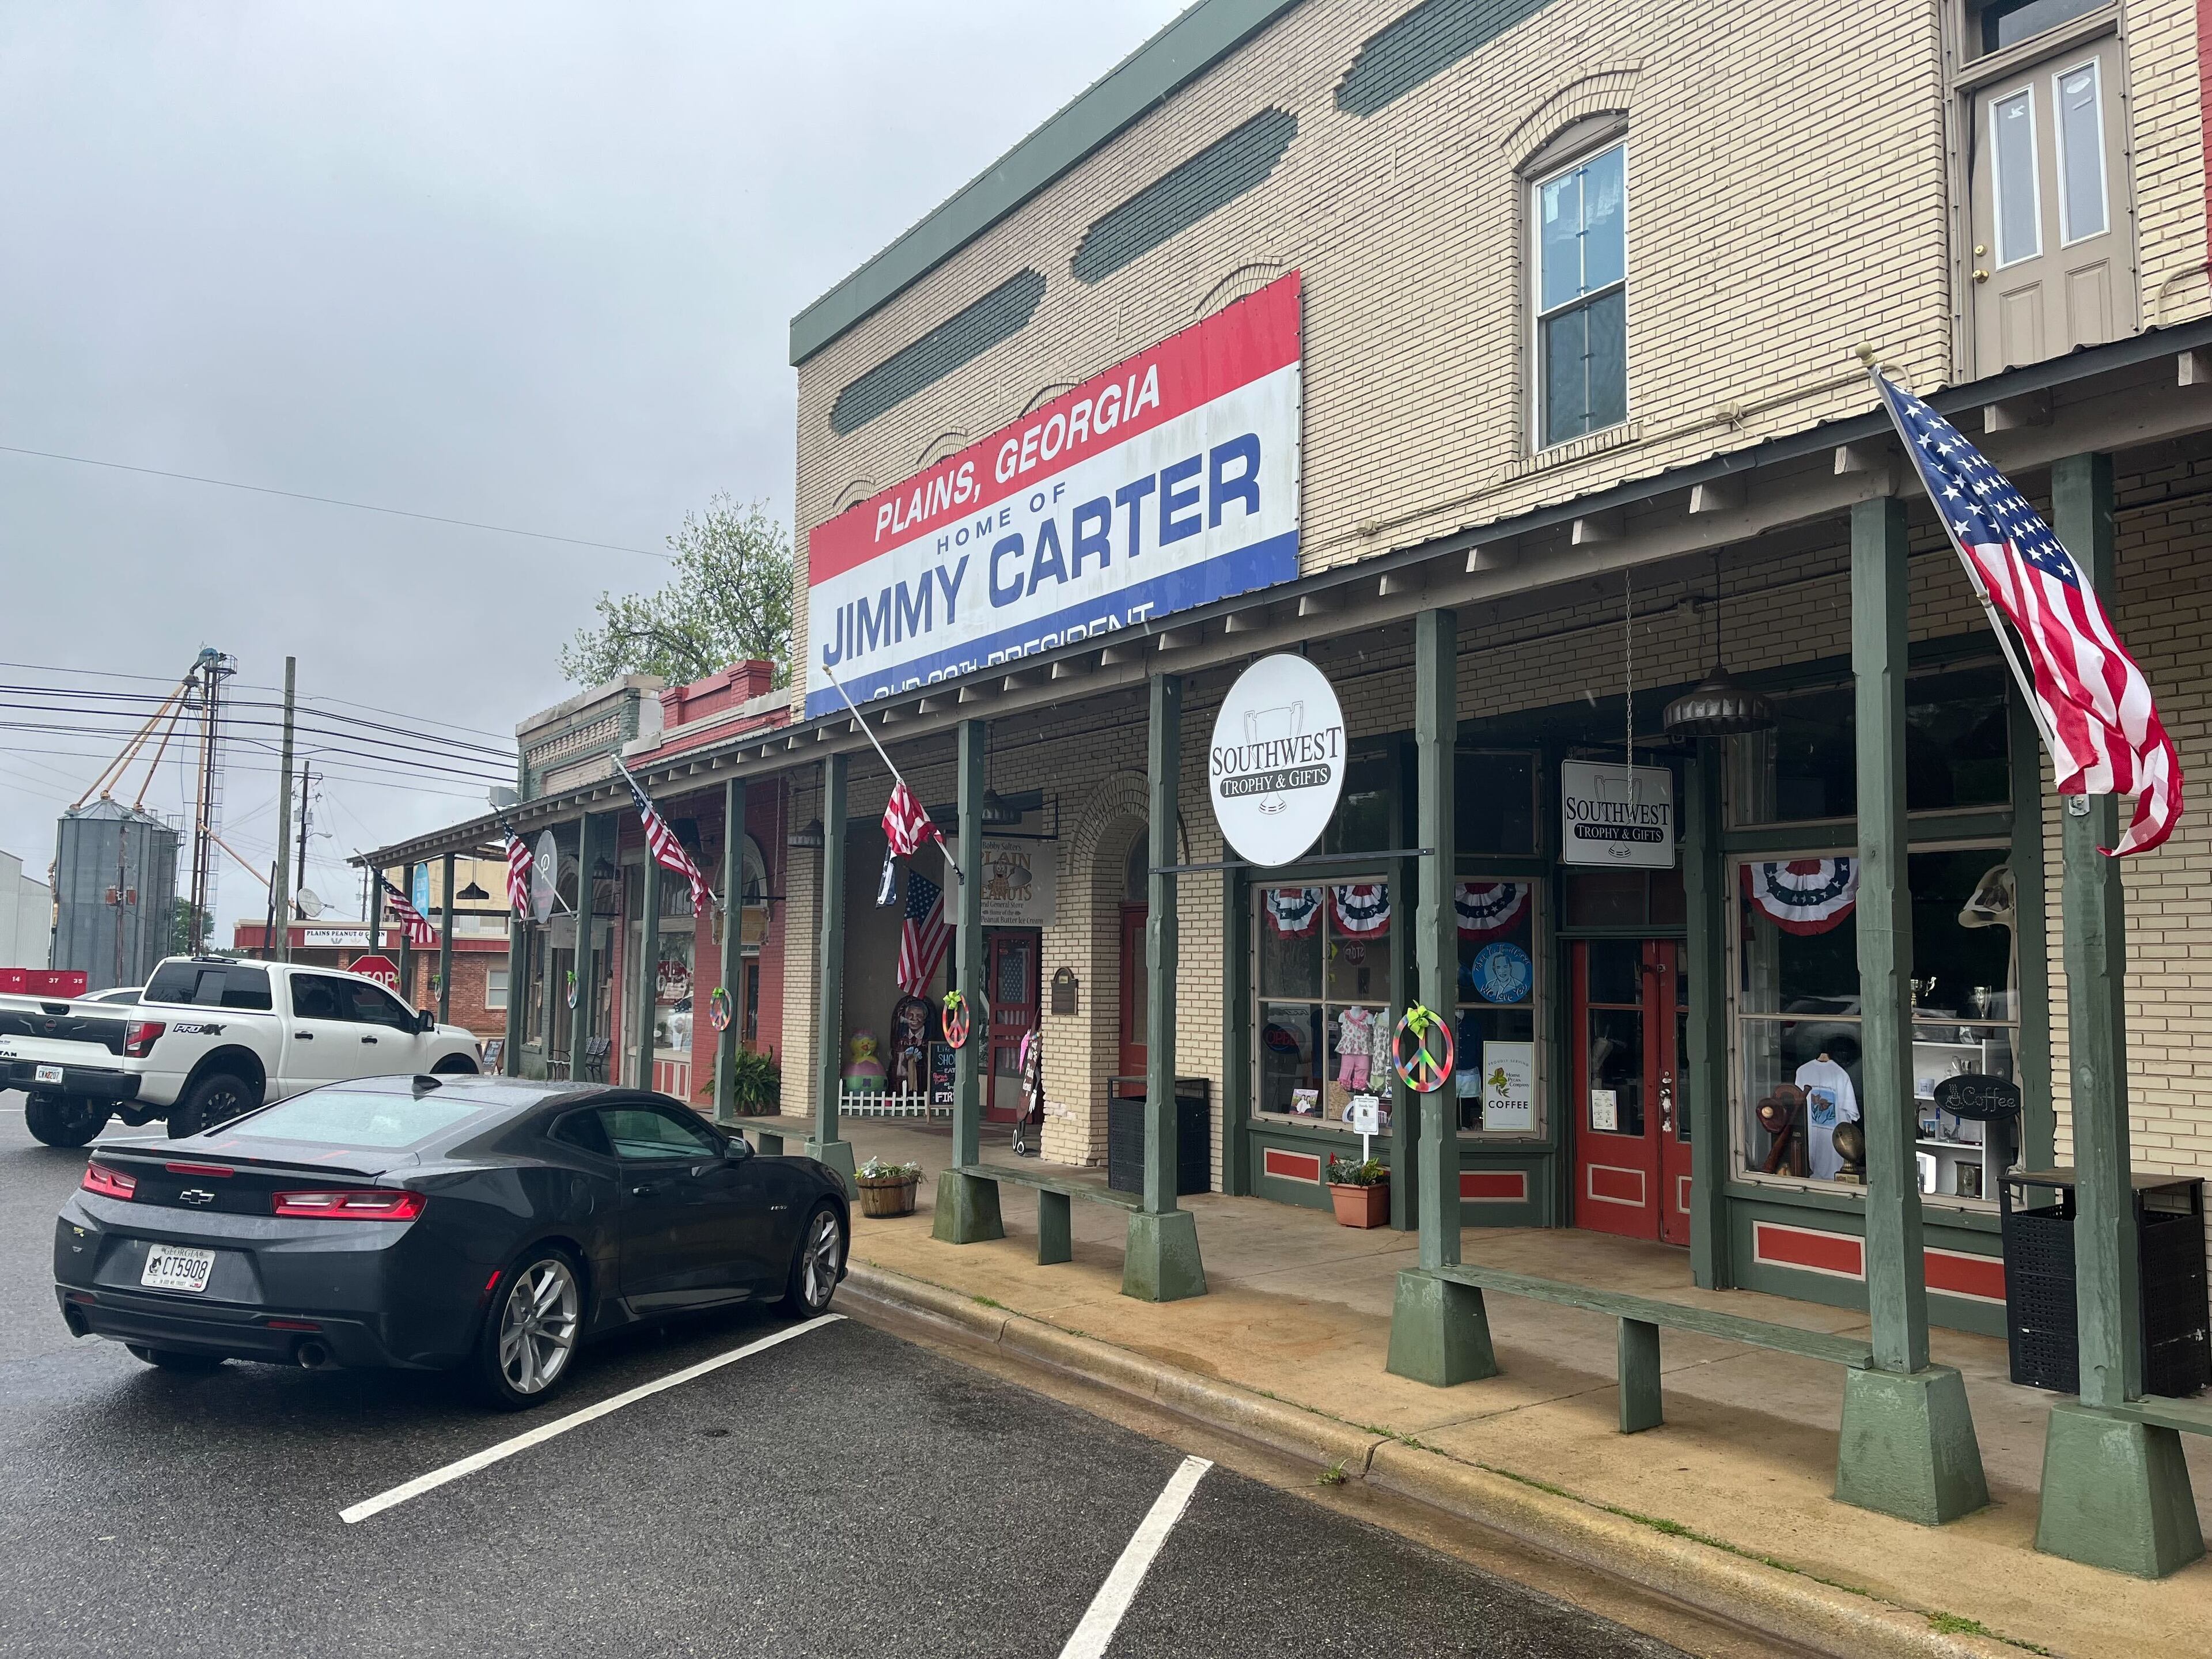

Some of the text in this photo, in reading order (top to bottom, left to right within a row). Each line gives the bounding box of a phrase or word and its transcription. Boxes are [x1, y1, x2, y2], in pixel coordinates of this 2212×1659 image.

[875, 363, 1160, 543] PLAINS, GEORGIA
[937, 482, 1066, 555] HOME OF
[822, 433, 1261, 668] JIMMY CARTER
[1212, 726, 1342, 777] SOUTHWEST
[1222, 767, 1328, 796] TROPHY & GIFTS
[1566, 797, 1670, 825] SOUTHWEST
[1577, 825, 1662, 842] TROPHY & GIFTS
[982, 842, 1001, 851] Bobby
[981, 884, 1032, 901] EANUTS
[353, 971, 395, 987] TOP
[938, 1054, 956, 1066] SHO
[935, 1091, 955, 1103] FIR
[1488, 1100, 1528, 1109] COFFEE
[1962, 1086, 2016, 1112] Coffee
[164, 1247, 198, 1257] GEORGIA
[162, 1256, 208, 1279] CT5908
